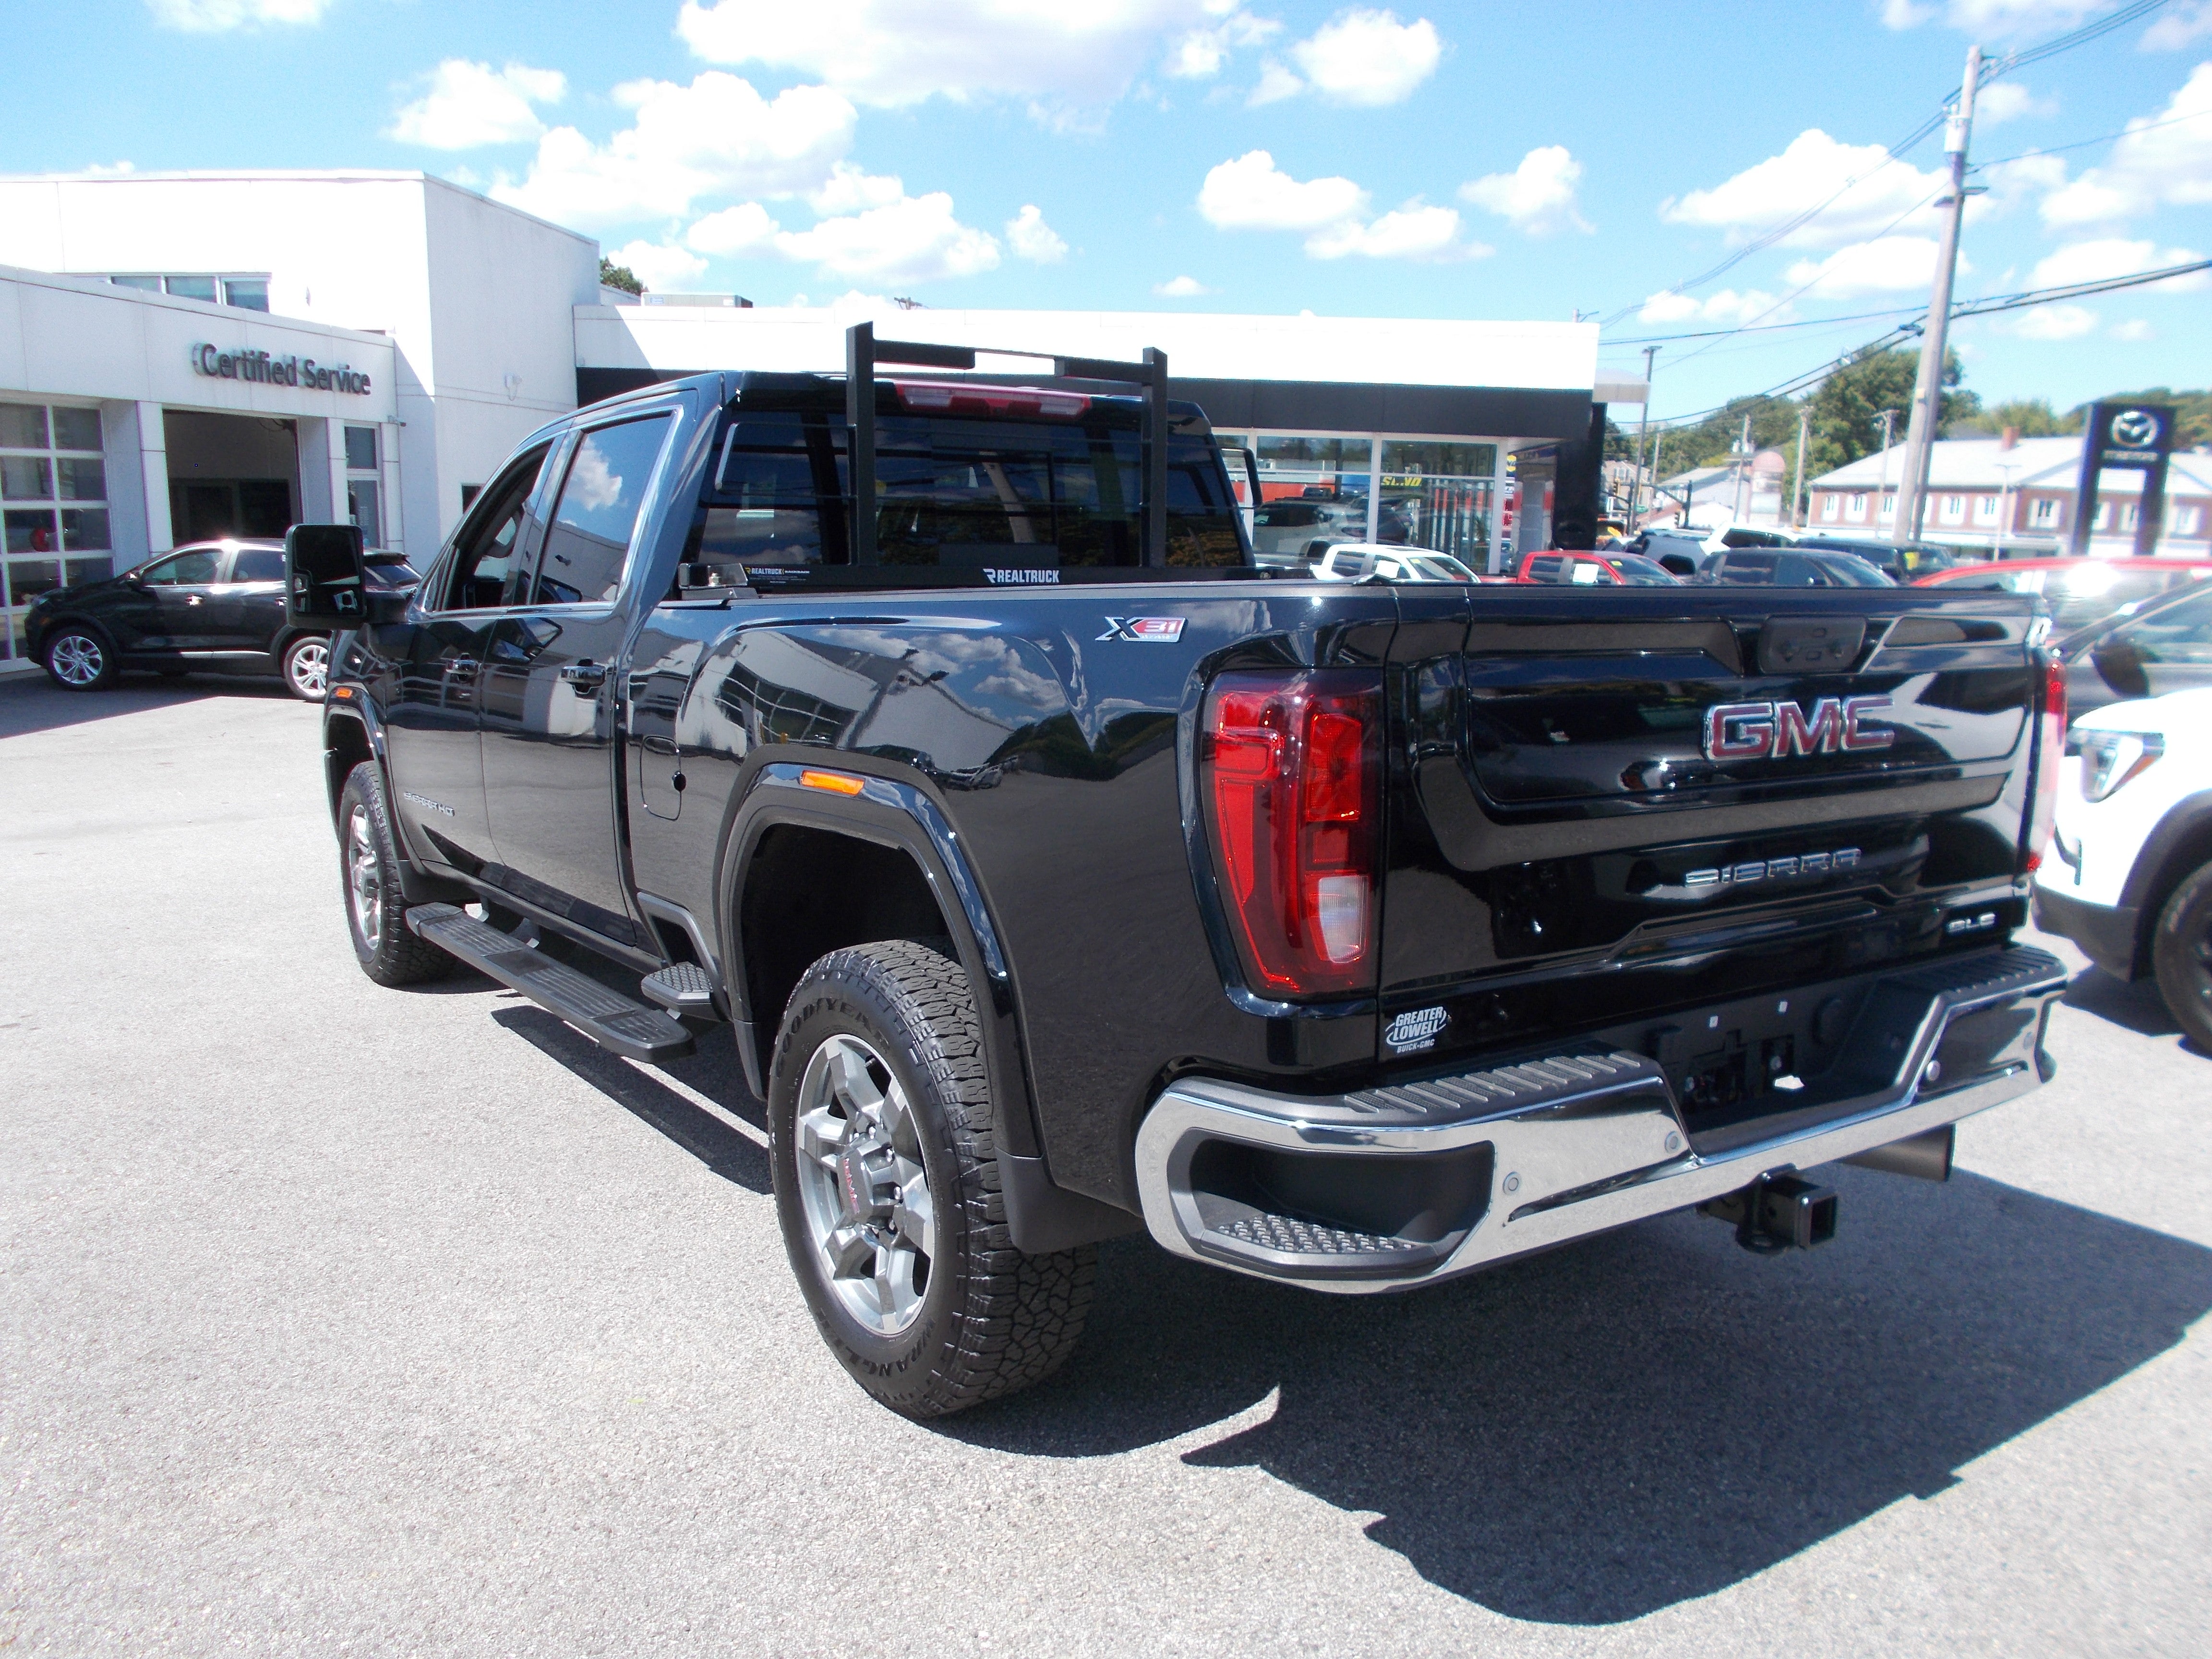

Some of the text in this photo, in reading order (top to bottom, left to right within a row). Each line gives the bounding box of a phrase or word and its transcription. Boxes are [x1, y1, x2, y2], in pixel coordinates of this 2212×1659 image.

[194, 342, 372, 396] Certified Service
[997, 569, 1060, 583] REALTRUCK
[1704, 694, 1895, 760] GMC
[403, 792, 456, 817] SIERRA HD
[1685, 847, 1862, 888] SIERRA
[1395, 1006, 1444, 1027] GREATER
[1393, 1019, 1439, 1041] LOWELL
